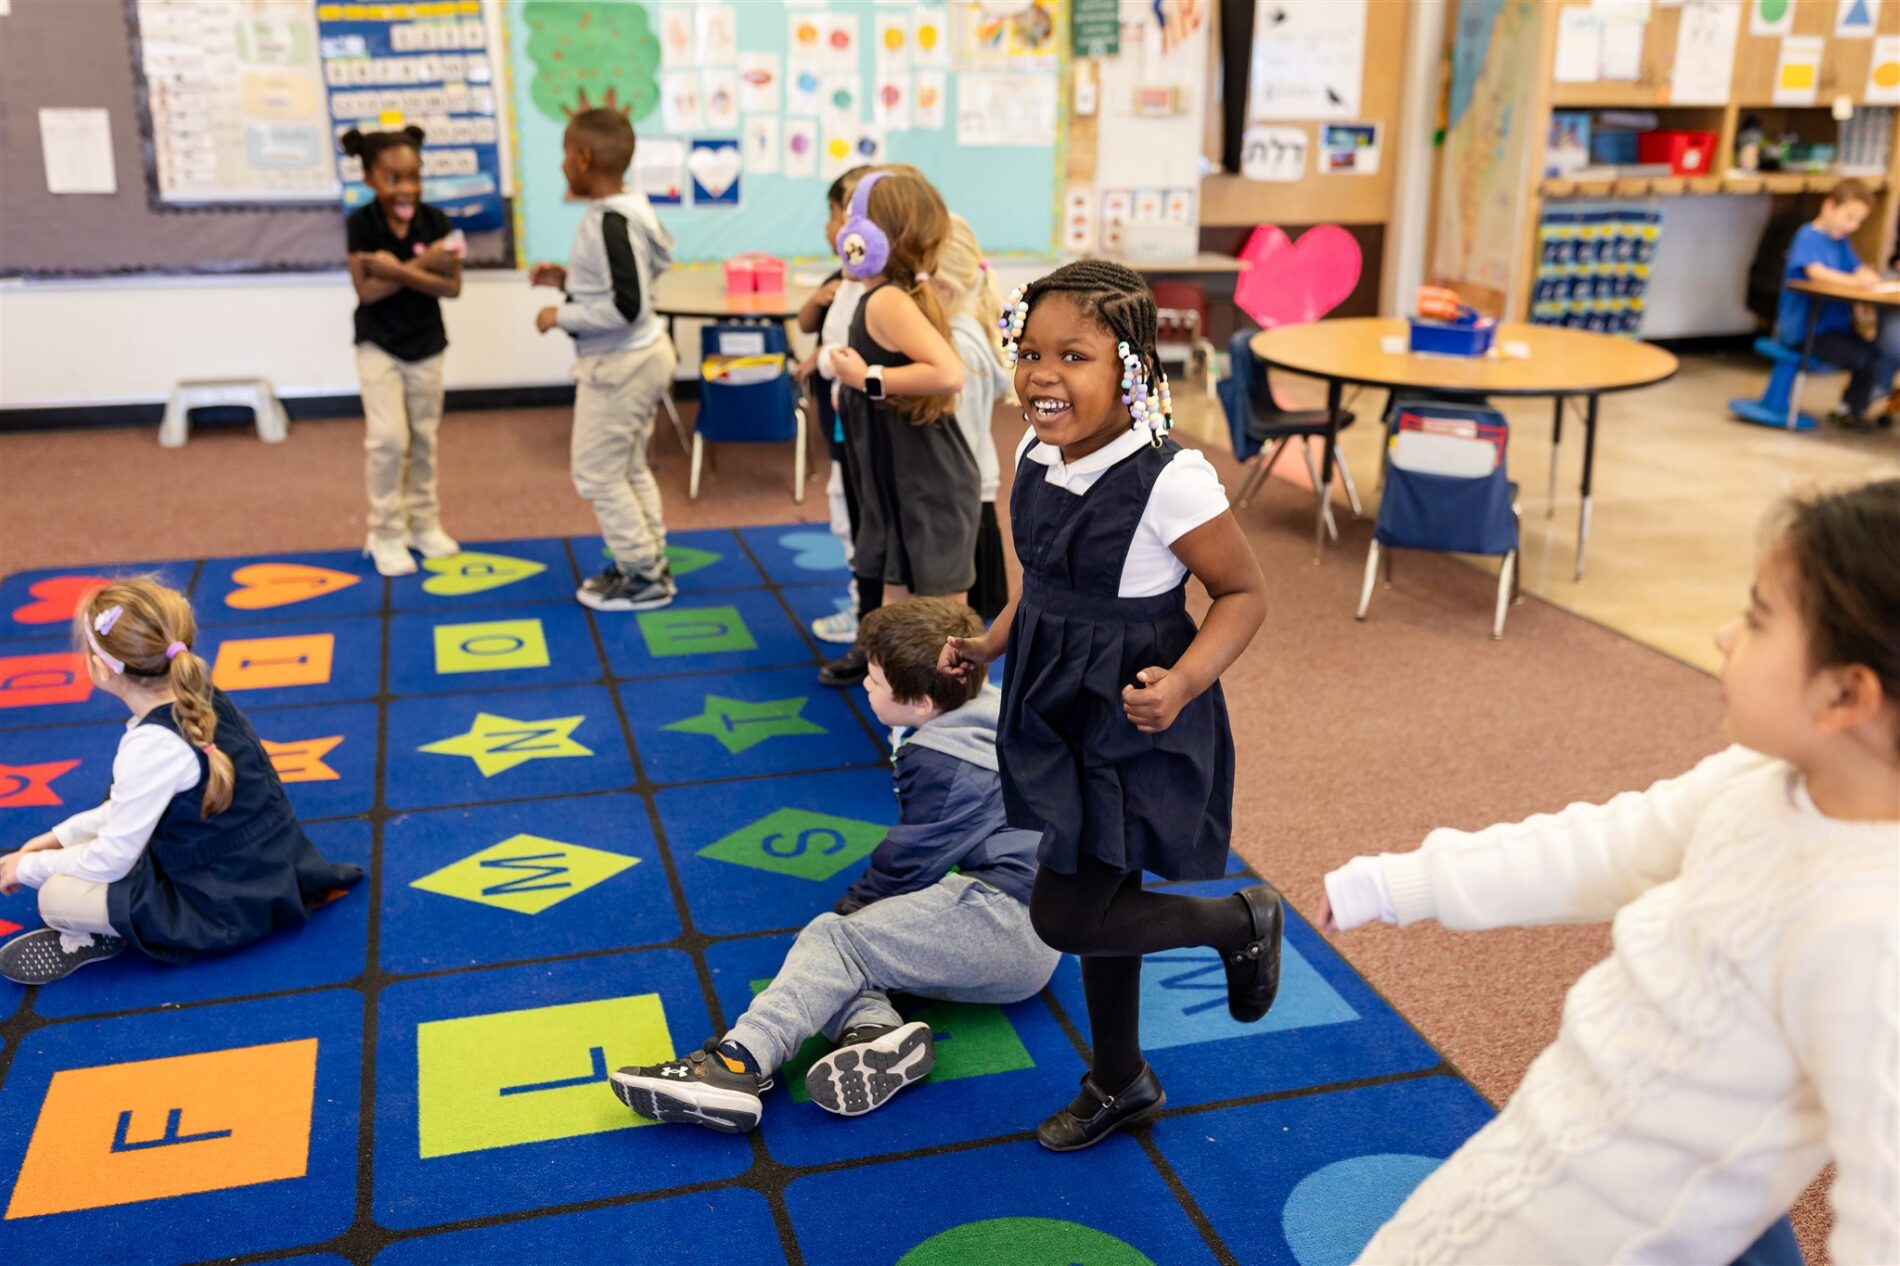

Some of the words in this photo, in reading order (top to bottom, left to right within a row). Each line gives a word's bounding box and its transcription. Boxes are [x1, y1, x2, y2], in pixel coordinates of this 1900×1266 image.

[460, 635, 524, 655] O
[665, 622, 729, 641] U
[722, 713, 792, 732] T
[484, 728, 560, 753] N
[761, 828, 845, 858] S
[480, 853, 572, 895] M
[500, 1046, 608, 1096] L
[110, 1107, 232, 1153] F
